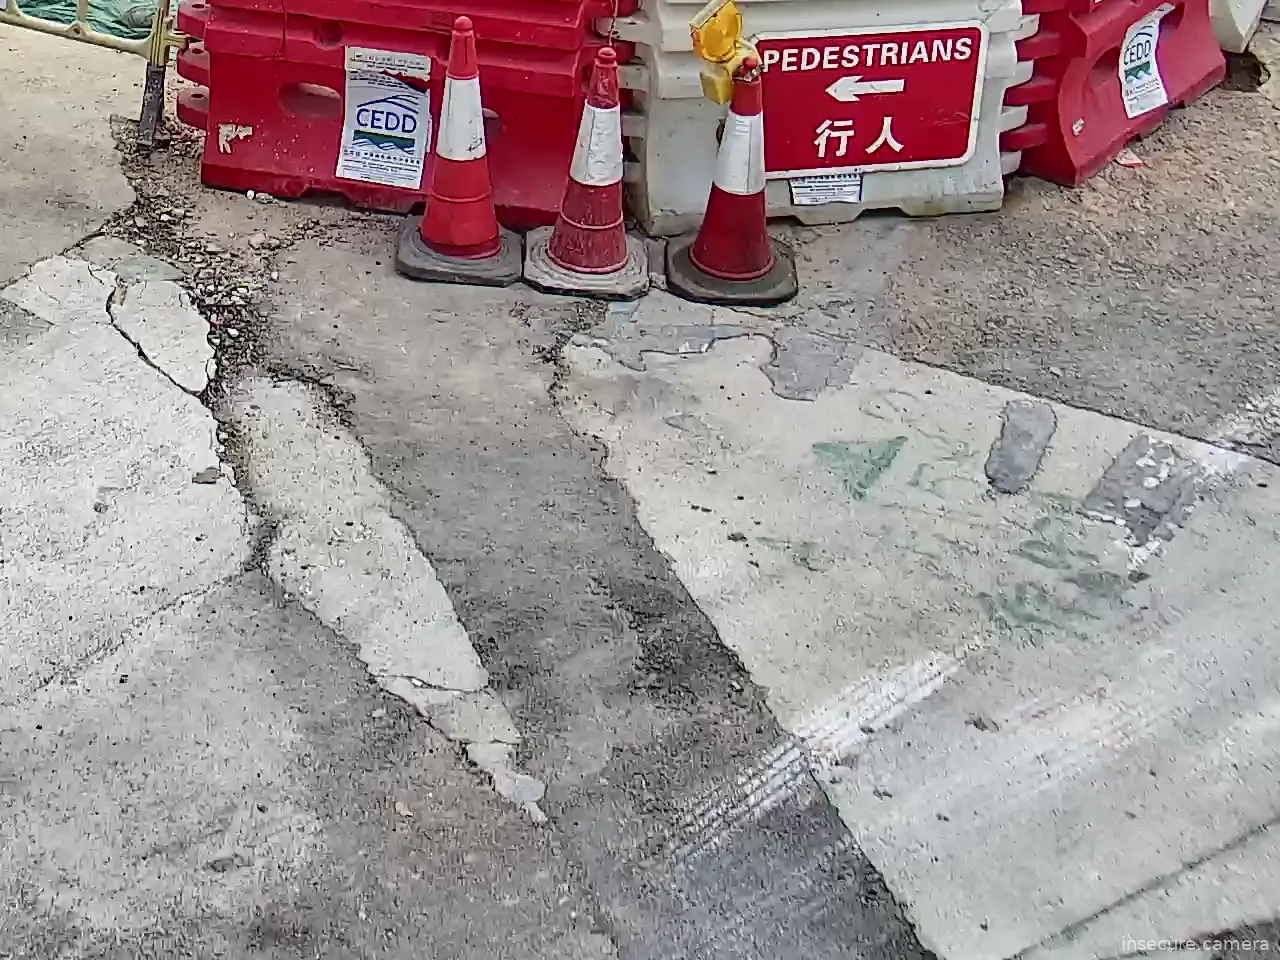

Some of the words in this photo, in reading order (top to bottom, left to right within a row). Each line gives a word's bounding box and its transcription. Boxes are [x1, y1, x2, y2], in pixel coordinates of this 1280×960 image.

[763, 37, 973, 73] PEDESTRIANS
[1123, 39, 1152, 66] CEDD
[356, 108, 417, 134] CEDD
[813, 116, 905, 158] 行人
